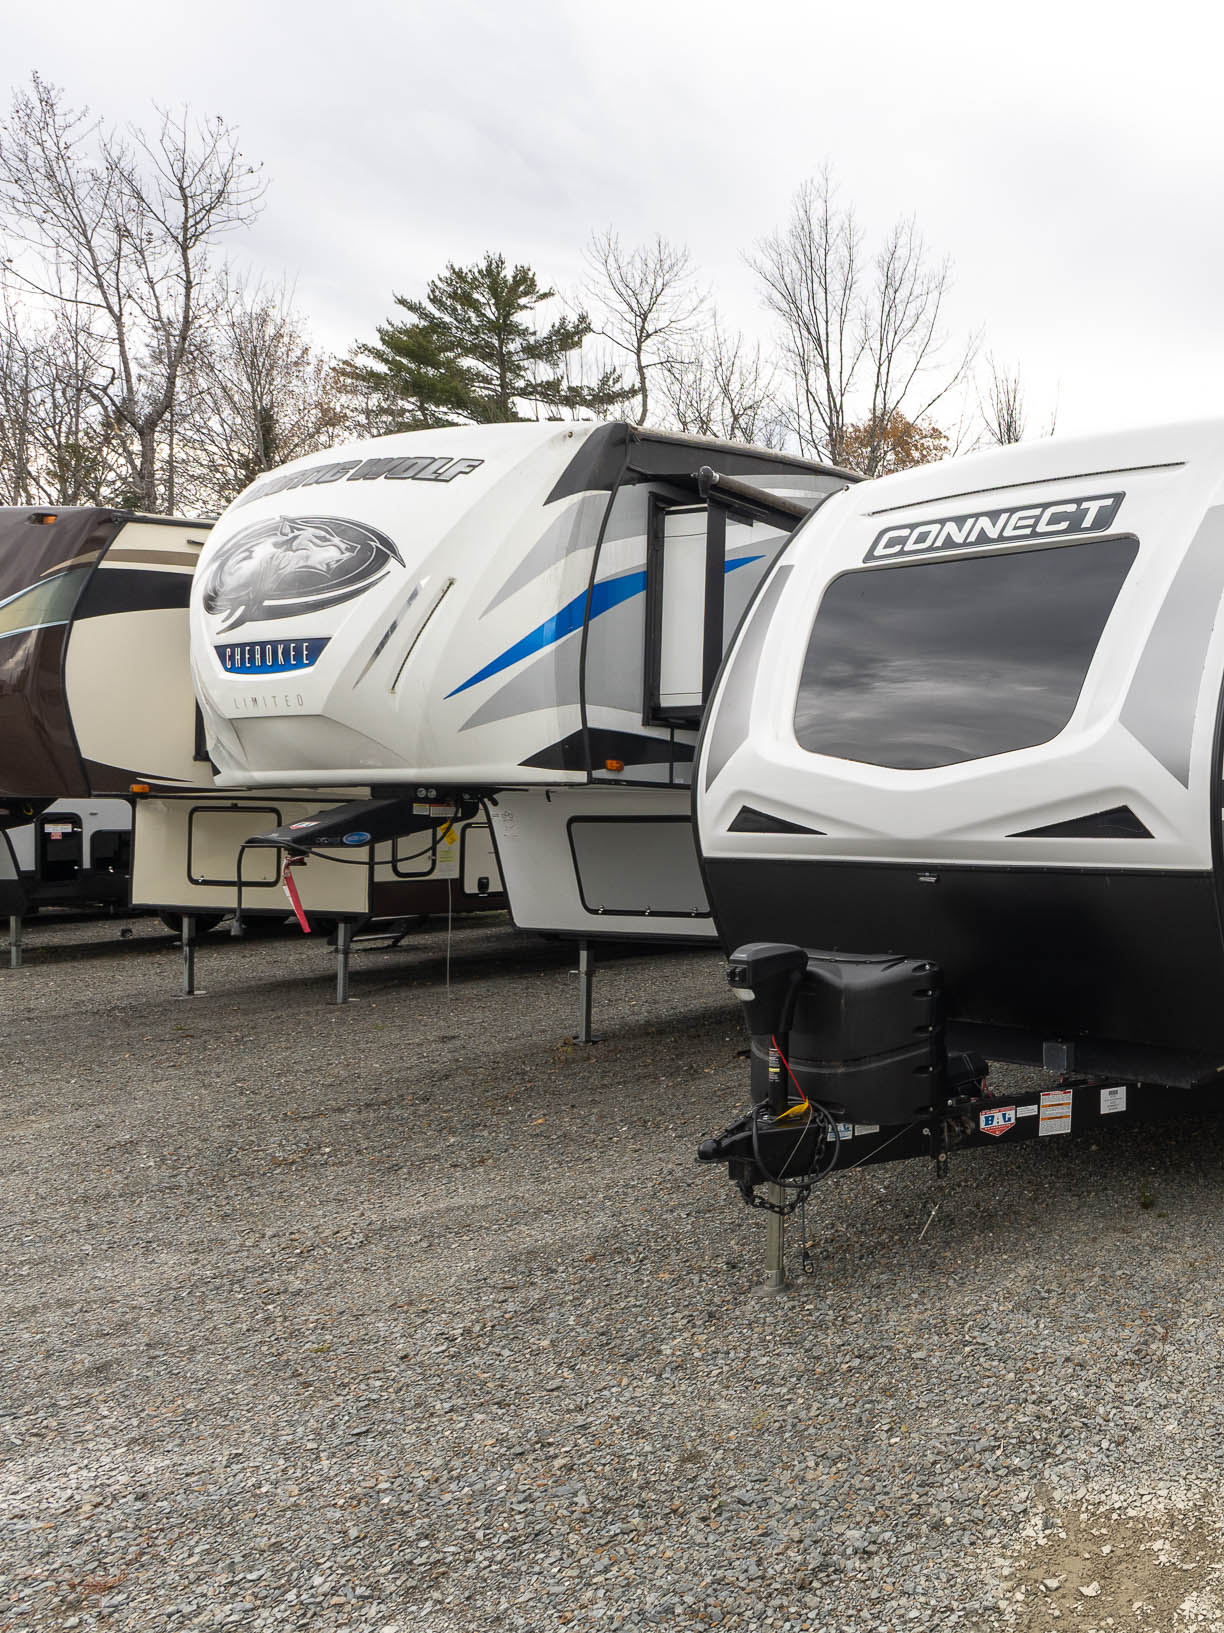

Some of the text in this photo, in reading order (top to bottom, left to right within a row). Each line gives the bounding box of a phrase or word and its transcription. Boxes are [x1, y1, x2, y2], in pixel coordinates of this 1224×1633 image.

[232, 456, 485, 511] TIC WOLF
[872, 497, 1115, 557] CONNECT
[226, 643, 310, 669] CHEROKEE
[232, 693, 305, 710] LIMITED
